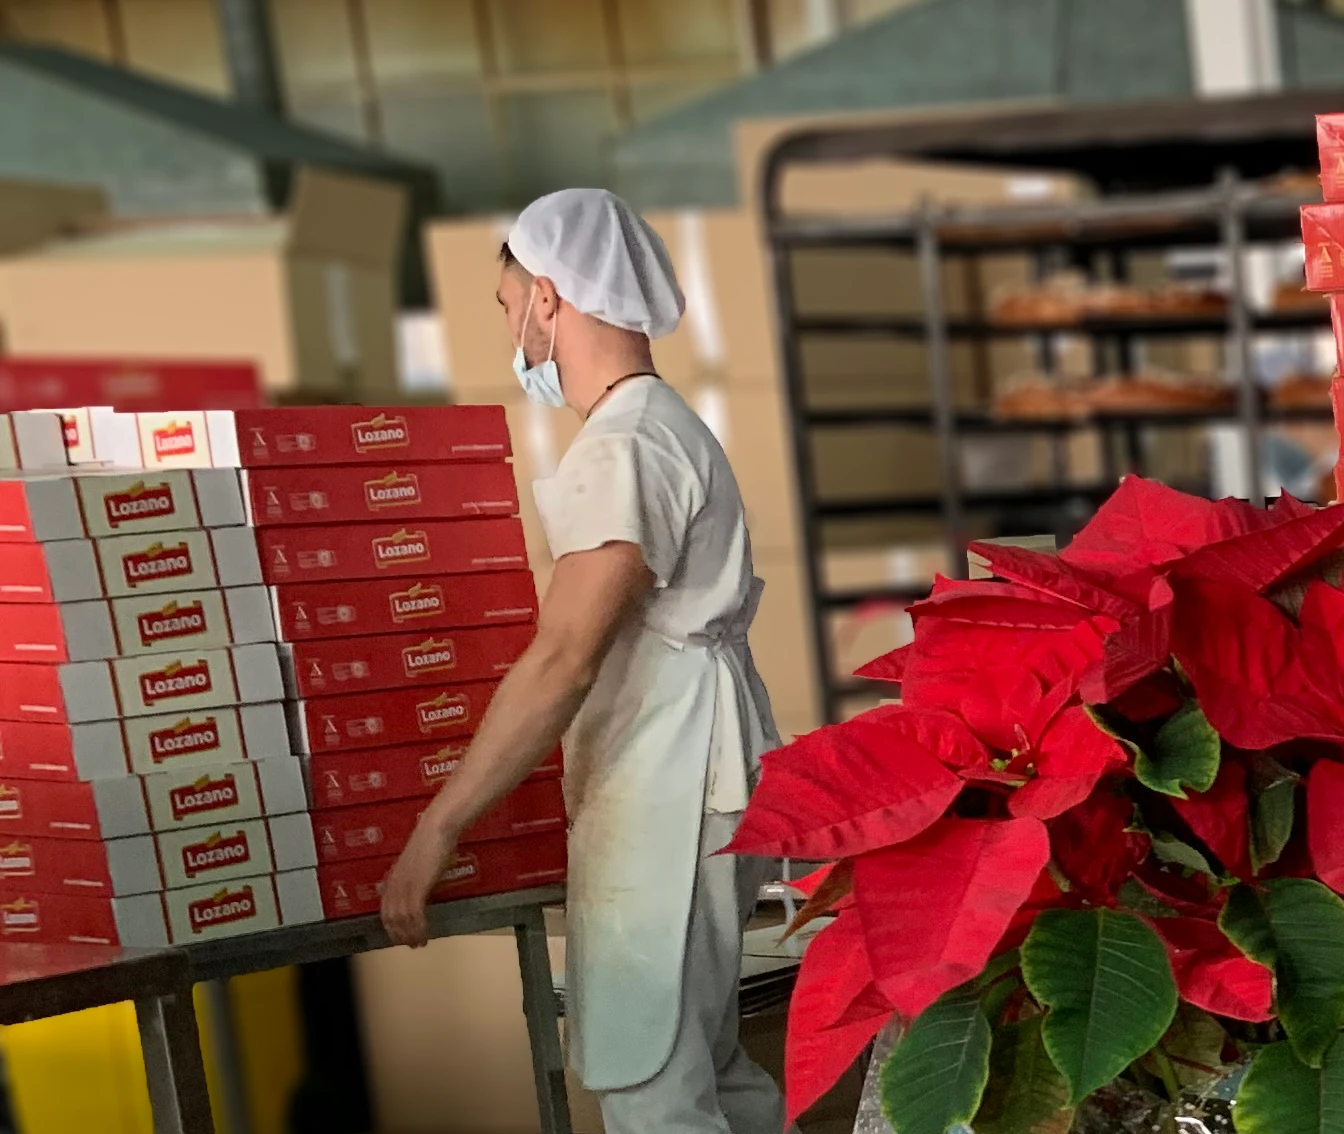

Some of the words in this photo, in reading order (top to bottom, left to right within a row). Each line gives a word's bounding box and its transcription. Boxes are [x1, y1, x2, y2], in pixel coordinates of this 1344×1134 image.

[356, 428, 404, 443] Lozano
[370, 485, 416, 500] Lozano
[108, 495, 170, 516] Lozano
[378, 542, 424, 558] Lozano
[128, 555, 188, 576] Lozano
[394, 596, 440, 612] Lozano
[142, 613, 201, 635] Lozano
[408, 651, 451, 667] Lozano
[145, 672, 207, 695] Lozano
[421, 704, 465, 722] Lozano
[154, 729, 215, 752] Lozano
[174, 786, 234, 809] Lozano
[187, 843, 245, 867] Lozano
[193, 899, 251, 923] Lozano
